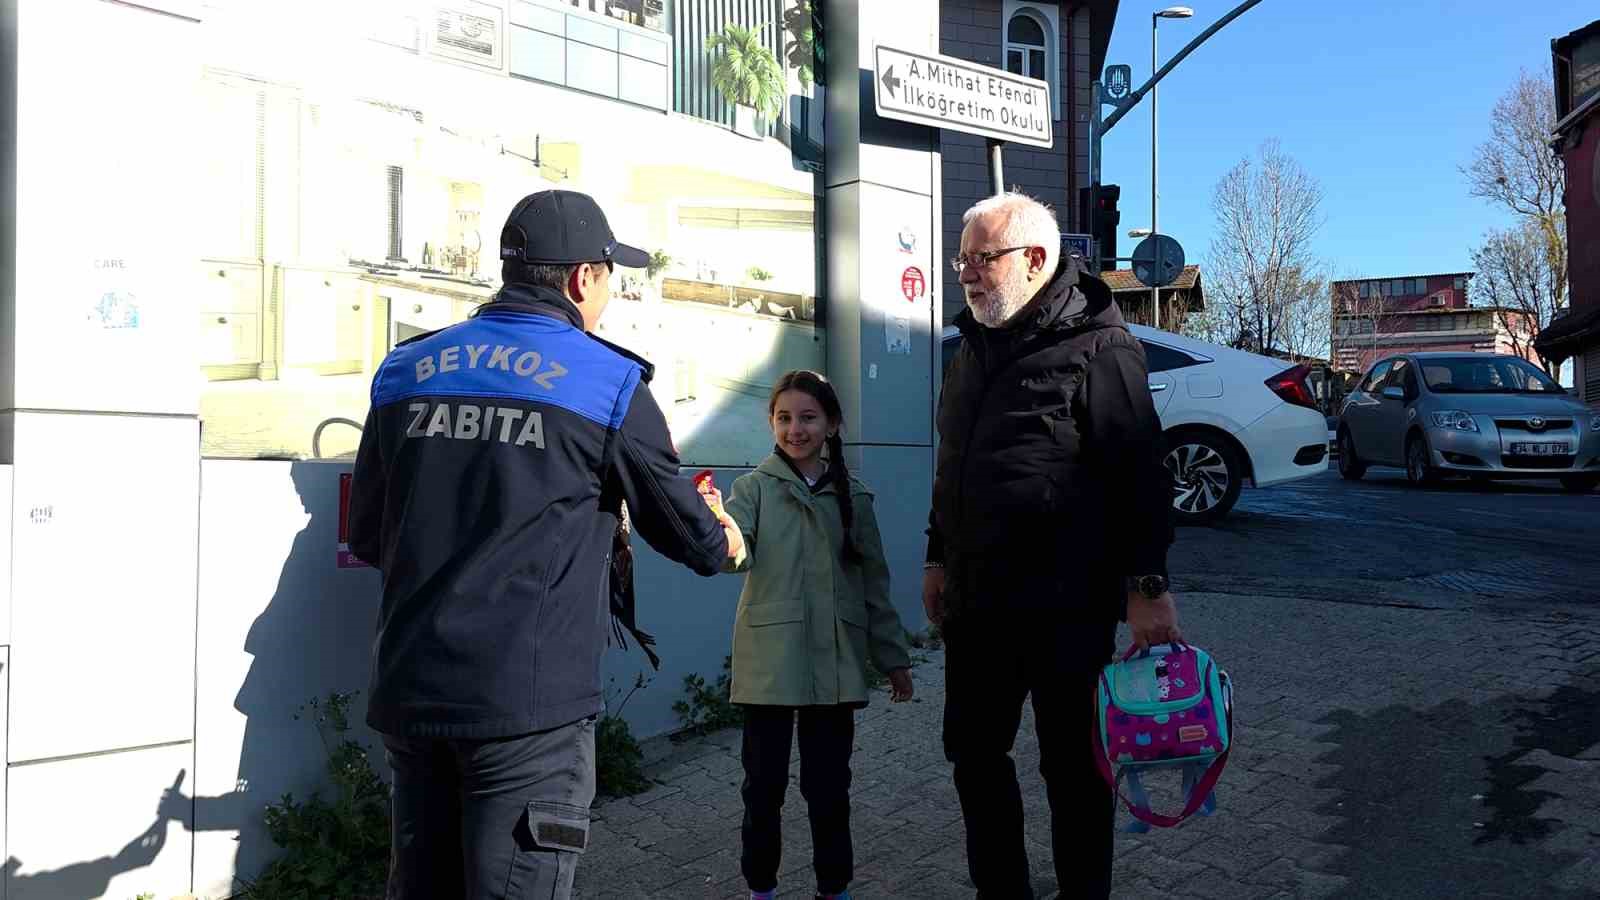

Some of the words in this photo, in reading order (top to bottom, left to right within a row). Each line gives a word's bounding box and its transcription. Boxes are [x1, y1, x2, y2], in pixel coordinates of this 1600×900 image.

[909, 58, 982, 93] A.Mithat
[988, 78, 1038, 106] Efendi
[1000, 106, 1044, 132] Okulu
[415, 344, 569, 390] BEYKOZ
[406, 402, 546, 450] ZABITA
